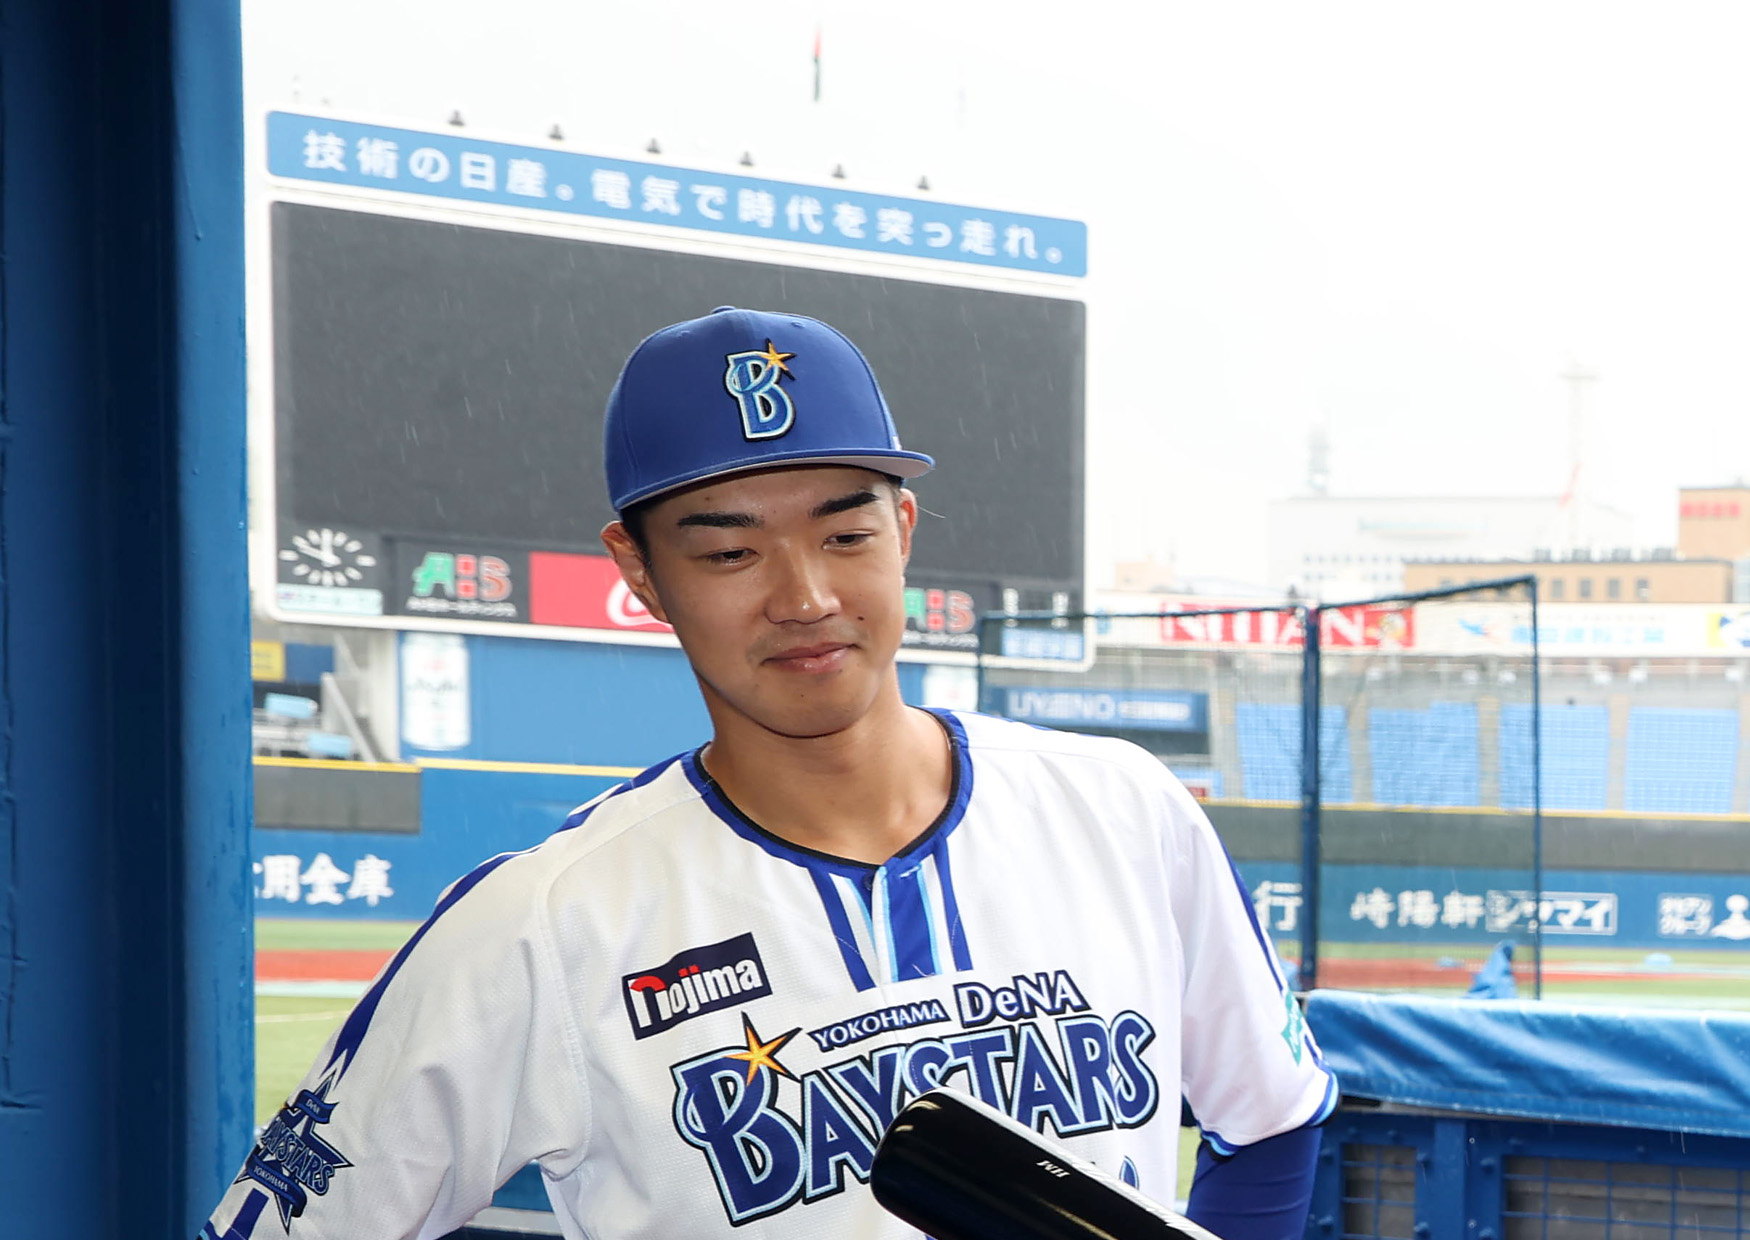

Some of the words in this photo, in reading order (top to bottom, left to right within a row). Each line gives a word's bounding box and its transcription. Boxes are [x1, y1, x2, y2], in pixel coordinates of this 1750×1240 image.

[303, 130, 1063, 264] 技術の日産。電気で時代を突っ走れ。
[724, 348, 796, 442] B
[252, 852, 394, 907] 用金庫
[812, 1001, 947, 1052] YOKOHAMA
[955, 972, 1086, 1026] DeNA
[261, 1115, 335, 1195] AYSTARS
